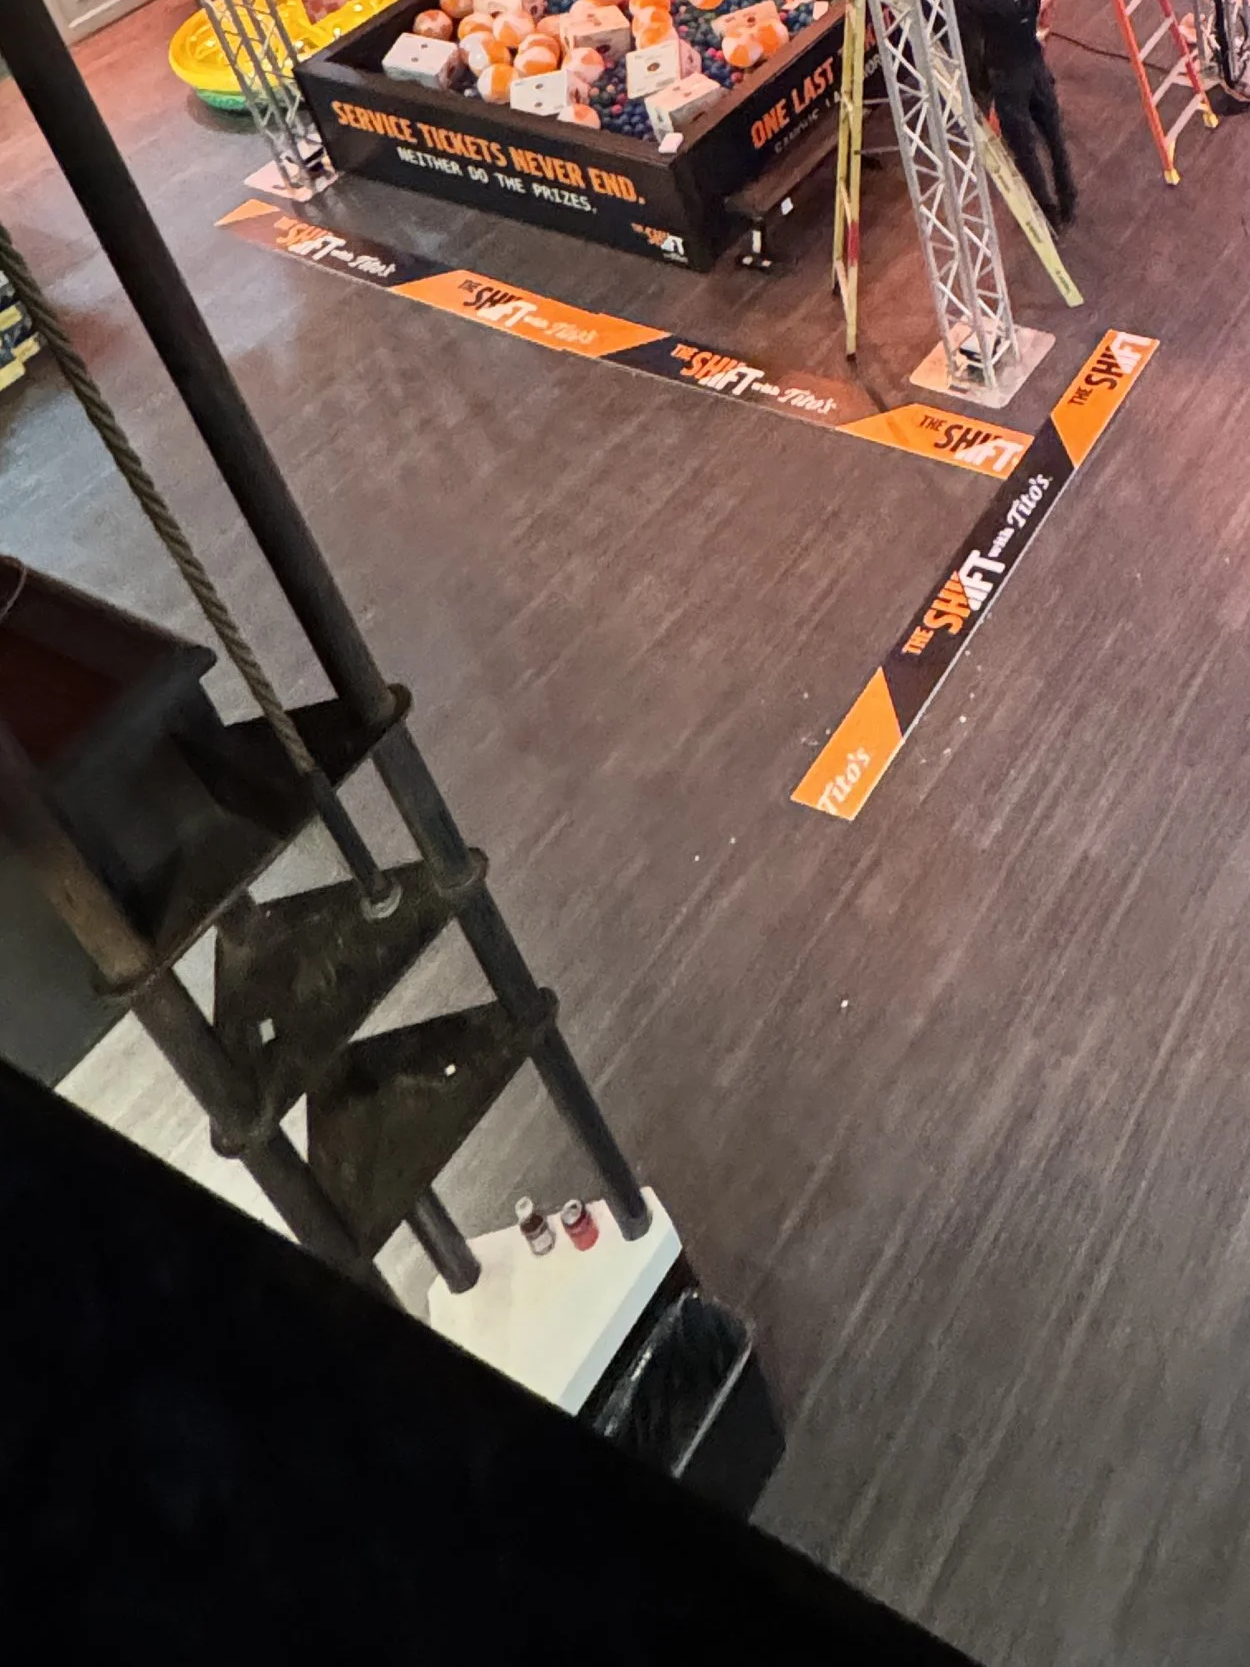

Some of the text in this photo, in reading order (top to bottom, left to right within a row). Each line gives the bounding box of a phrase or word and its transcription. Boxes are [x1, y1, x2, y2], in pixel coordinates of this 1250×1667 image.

[751, 98, 789, 149] ONE
[791, 56, 835, 115] LAST
[331, 100, 647, 205] SERVICE TICKETS NEVER END.
[396, 146, 598, 215] NEITHER DO THE PRIZES.
[679, 351, 765, 396] SHIFT
[1067, 332, 1152, 407] THE SHIFT
[919, 415, 1024, 472] THE SHIFT
[902, 626, 935, 655] THE
[923, 549, 1006, 635] SHIFT
[1006, 473, 1051, 530] Tito's
[817, 746, 870, 816] Tito's
